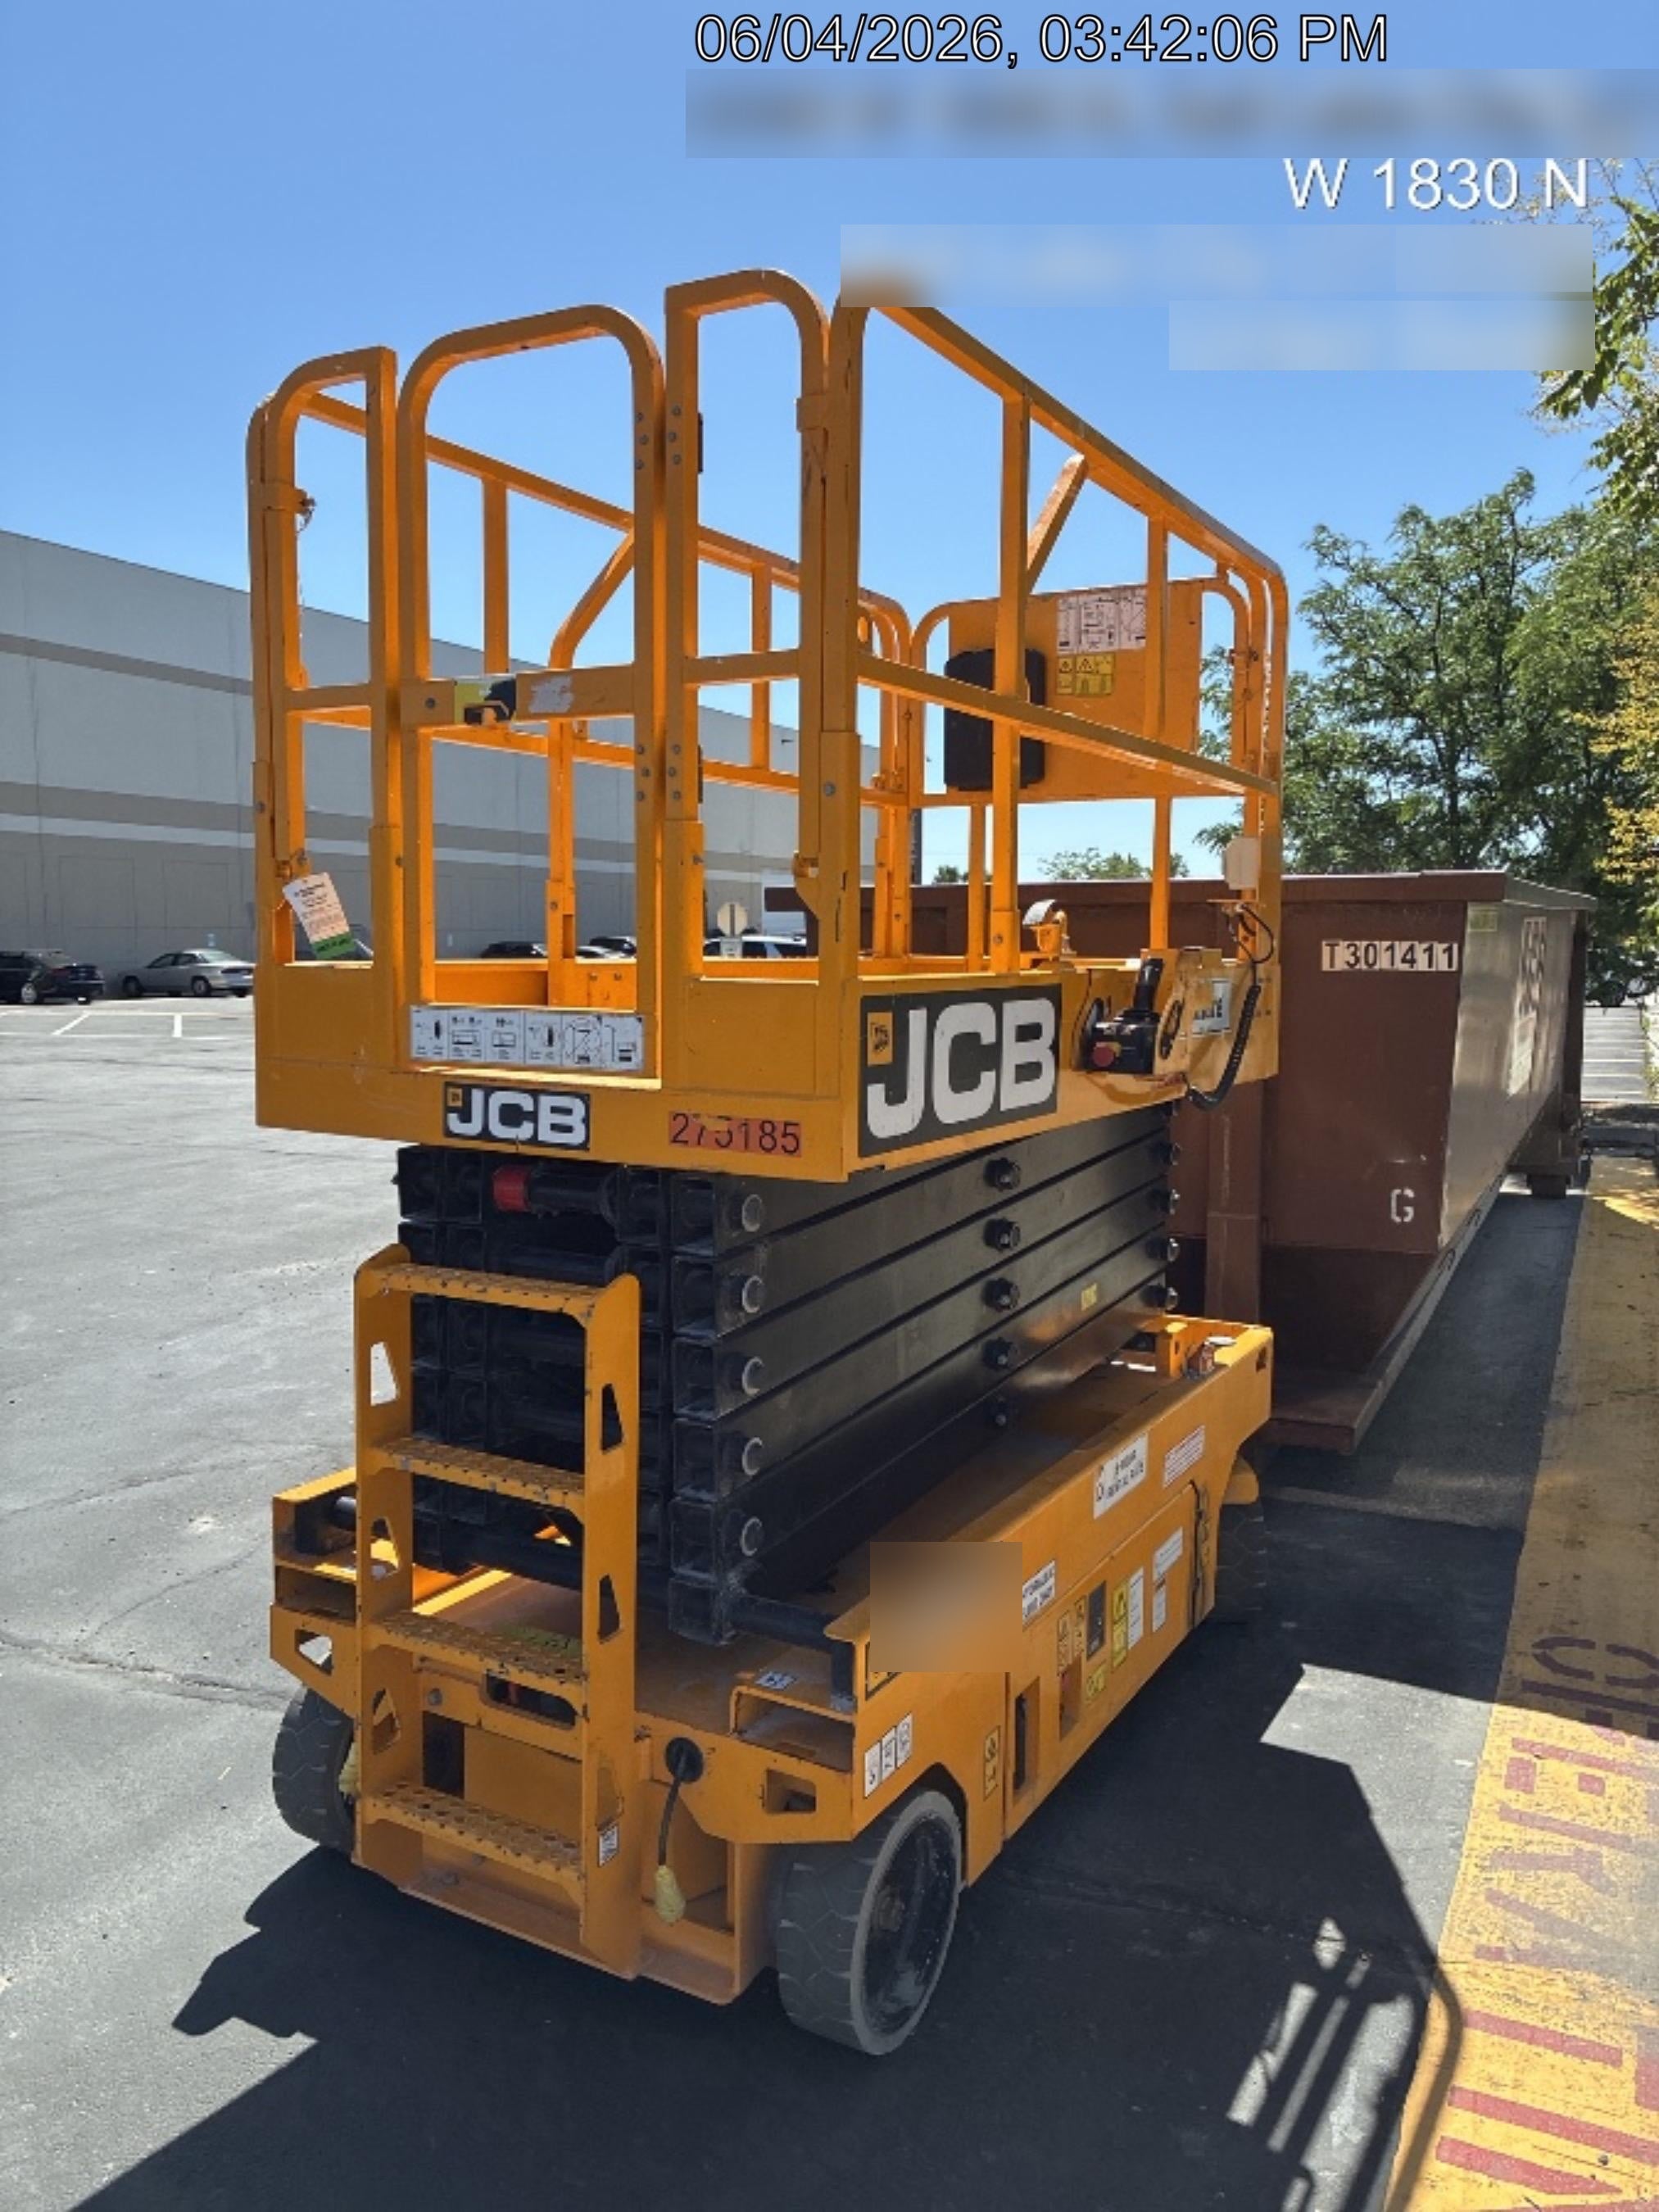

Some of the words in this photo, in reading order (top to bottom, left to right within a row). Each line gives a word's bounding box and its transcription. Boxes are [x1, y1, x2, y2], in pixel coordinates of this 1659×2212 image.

[1324, 943, 1454, 969] T301411
[867, 997, 1056, 1139] JCB
[446, 1088, 587, 1146] JCB
[1390, 1188, 1415, 1223] G
